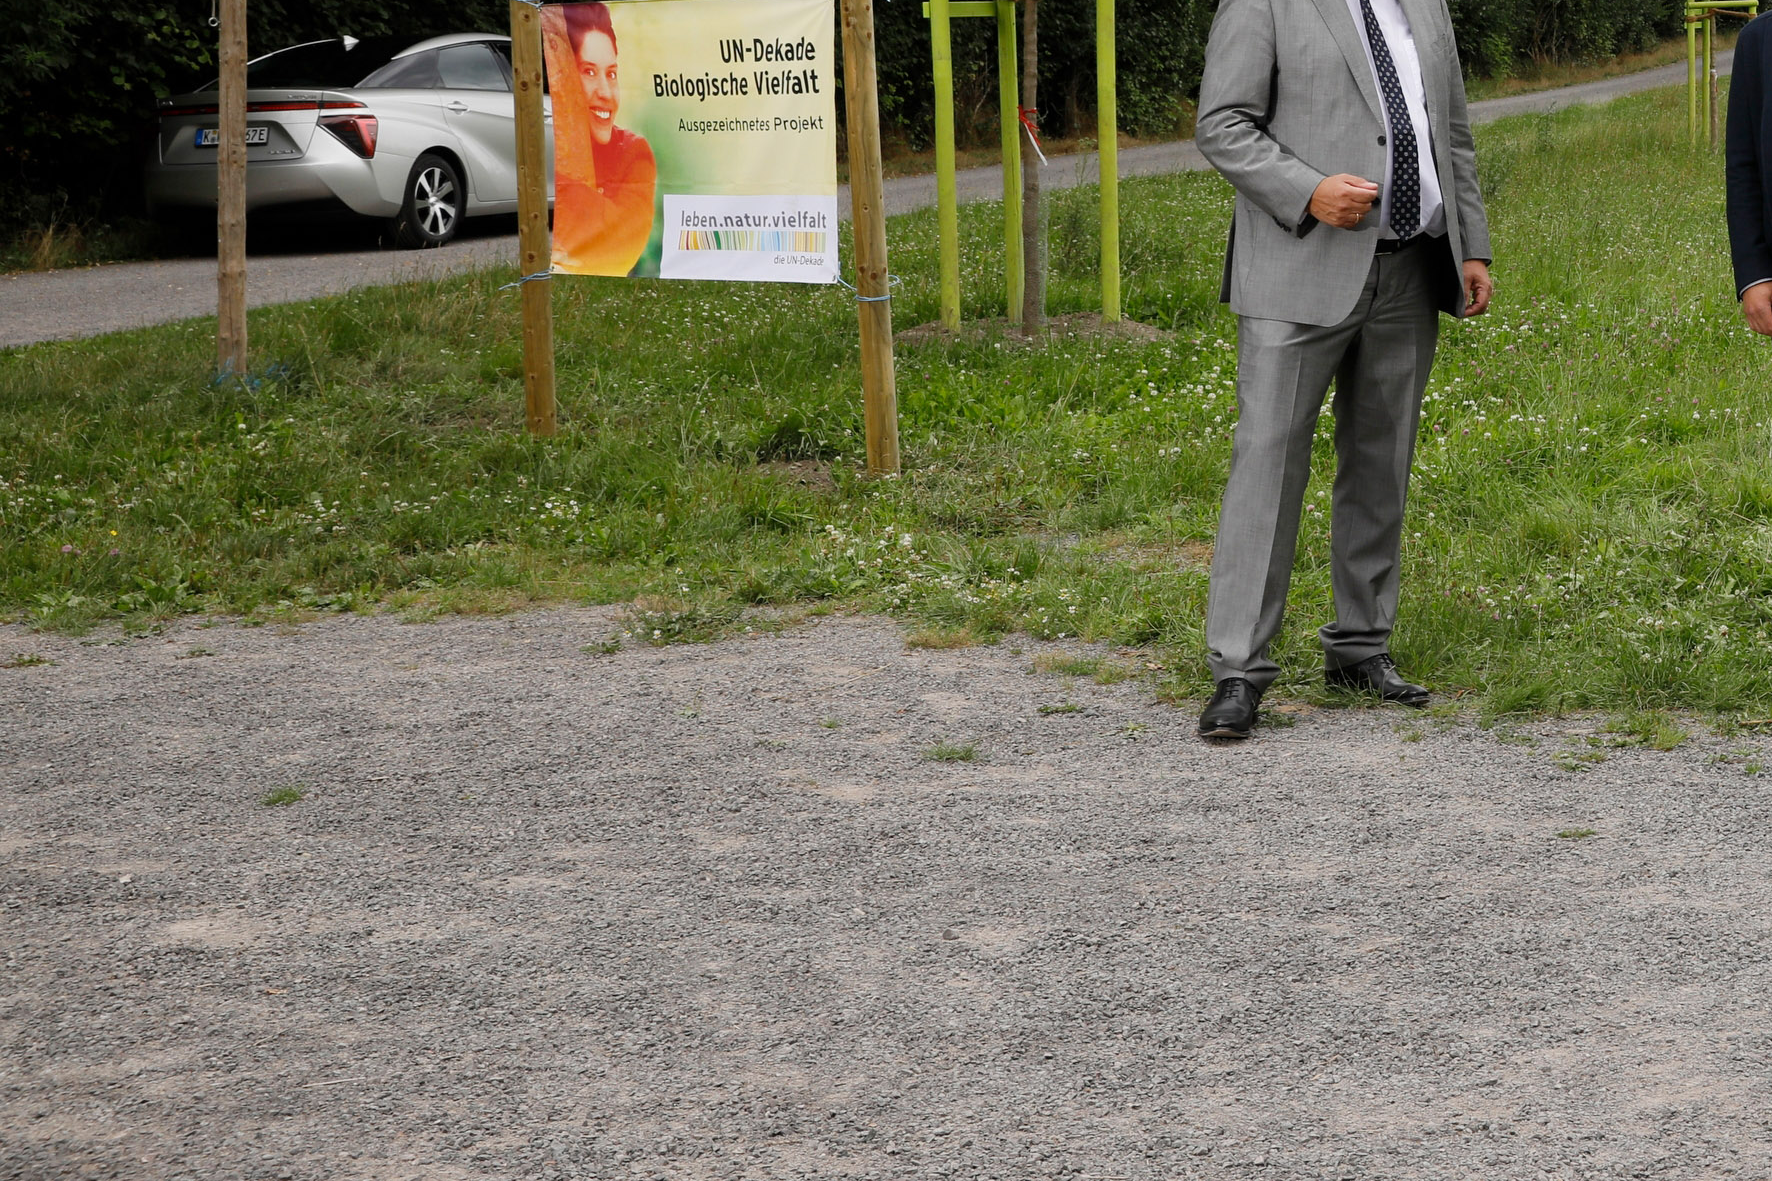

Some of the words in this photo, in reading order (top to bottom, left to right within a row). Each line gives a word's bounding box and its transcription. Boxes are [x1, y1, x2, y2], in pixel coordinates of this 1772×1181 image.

[719, 36, 816, 64] UN-Dekade
[653, 73, 748, 102] Biologische
[753, 69, 820, 95] Vielfalt
[678, 117, 770, 135] Ausgezeichnetes
[774, 116, 824, 134] Projekt
[681, 210, 827, 229] leben.natur.vielfalt
[774, 255, 786, 265] die
[786, 255, 824, 266] UN-Dekade
